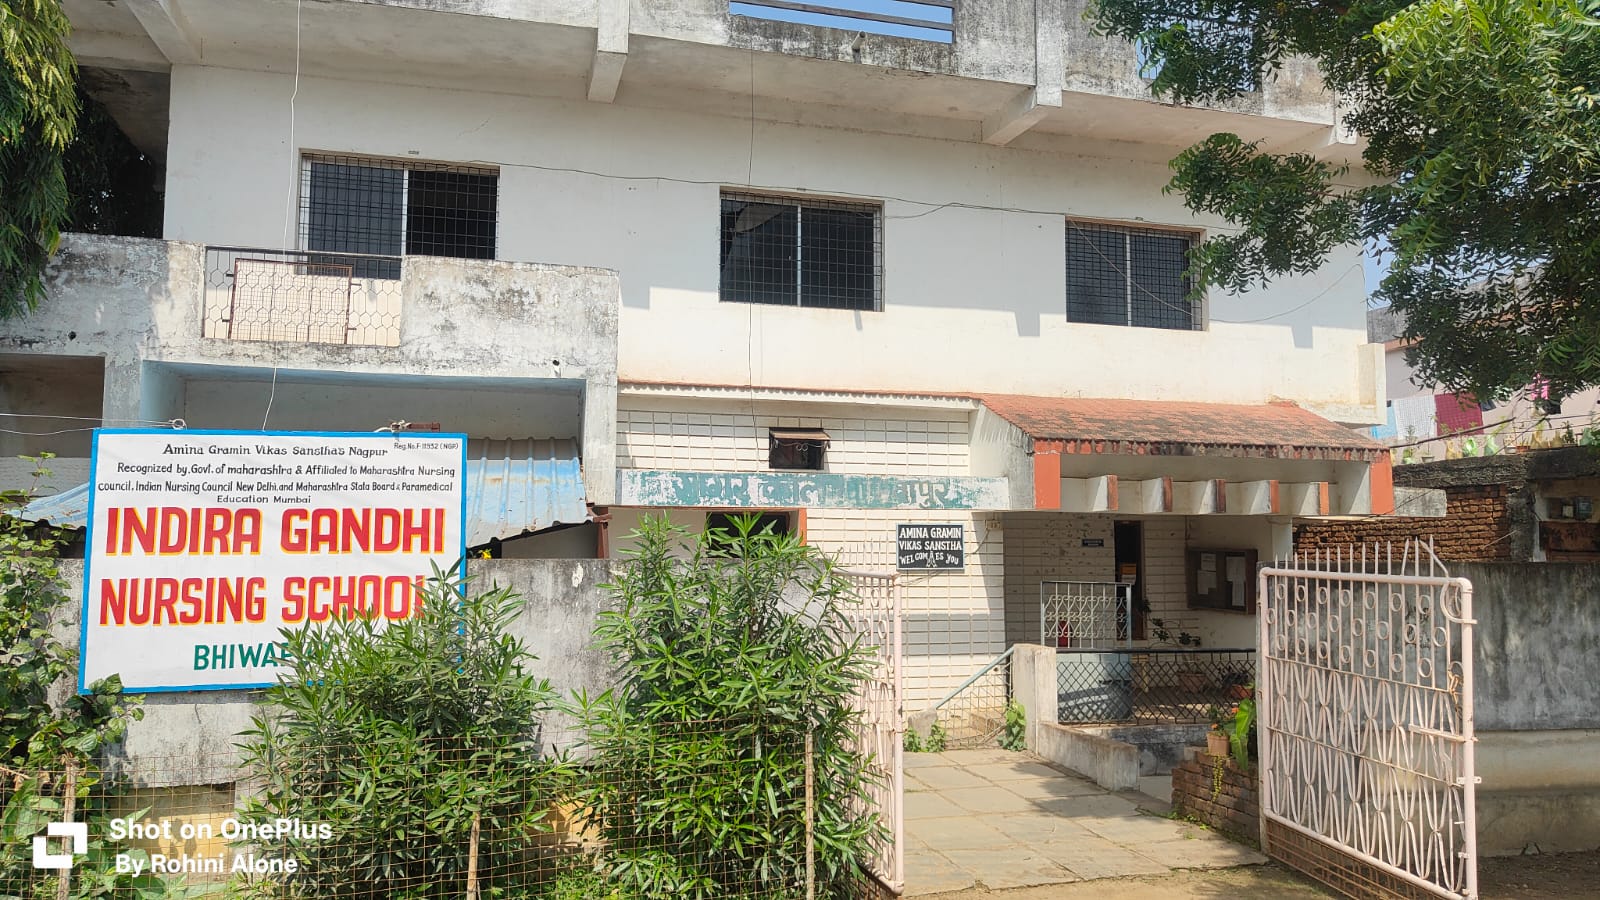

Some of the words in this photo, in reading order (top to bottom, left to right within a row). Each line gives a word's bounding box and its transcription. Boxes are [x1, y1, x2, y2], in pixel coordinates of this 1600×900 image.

[162, 444, 204, 455] Amina
[208, 445, 251, 455] Gramin
[255, 445, 288, 455] Vikas
[349, 447, 388, 459] Nagpur
[117, 462, 172, 475] Recognized
[227, 464, 292, 475] maharashtra
[295, 465, 302, 475] &
[305, 465, 347, 475] Affiliated
[350, 465, 358, 475] to
[360, 466, 415, 476] Maharashtra
[418, 466, 455, 478] Nursing
[165, 481, 200, 494] Nursing
[202, 482, 233, 492] Council
[236, 482, 254, 491] New
[296, 482, 348, 491] Maharashtra
[372, 482, 395, 491] Board
[402, 482, 453, 491] Paramedical
[217, 495, 269, 503] Education
[273, 495, 311, 504] Mumbai
[105, 507, 263, 556] INDIRA
[280, 507, 446, 555] GANDHI
[899, 527, 929, 539] AMINA
[930, 527, 961, 539] GRAMIN
[899, 540, 922, 551] VIKAS
[924, 540, 962, 551] SANSTHA
[99, 576, 266, 626] NURSING
